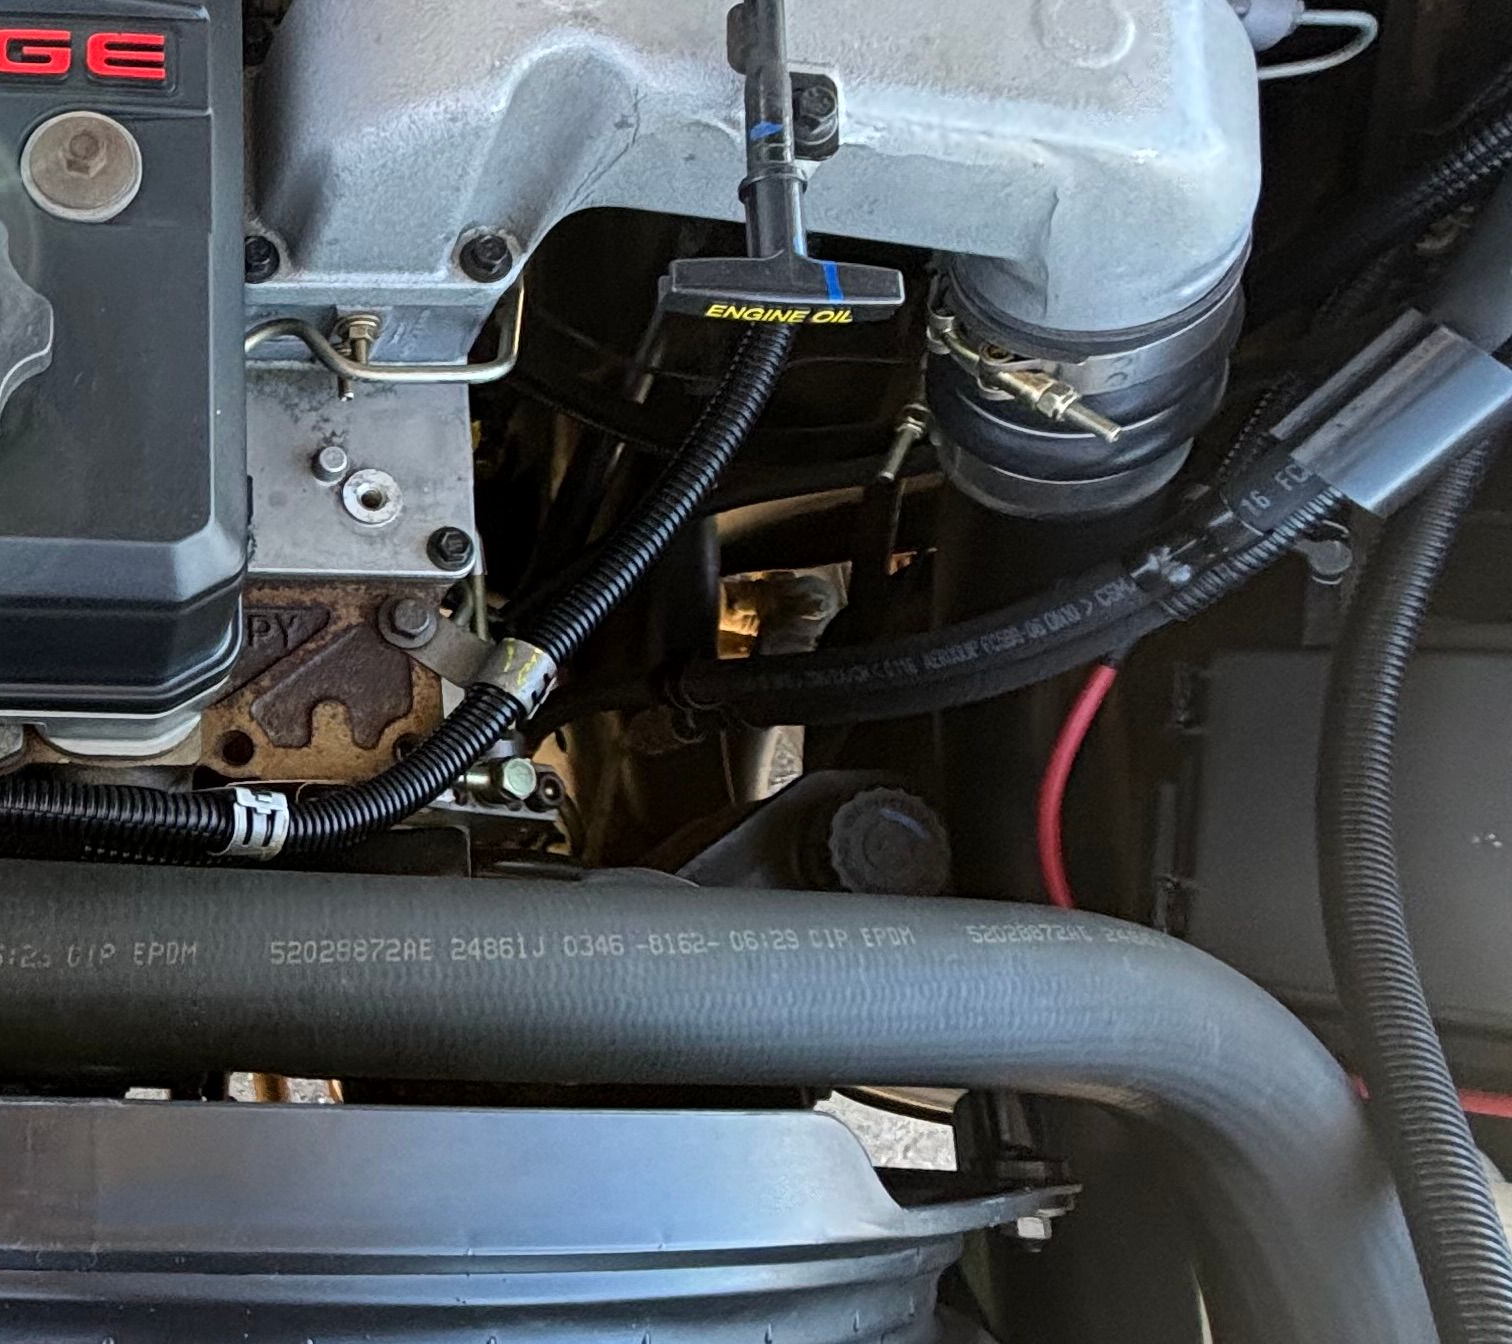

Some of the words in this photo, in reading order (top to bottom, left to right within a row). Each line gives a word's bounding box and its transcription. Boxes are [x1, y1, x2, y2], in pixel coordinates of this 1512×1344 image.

[705, 304, 811, 324] ENGINE
[810, 310, 853, 324] OIL
[133, 940, 198, 967] EPDM
[270, 936, 433, 966] 52028872AE
[450, 932, 545, 962] 24861J
[563, 932, 625, 958] 0346
[859, 925, 917, 948] EPDM
